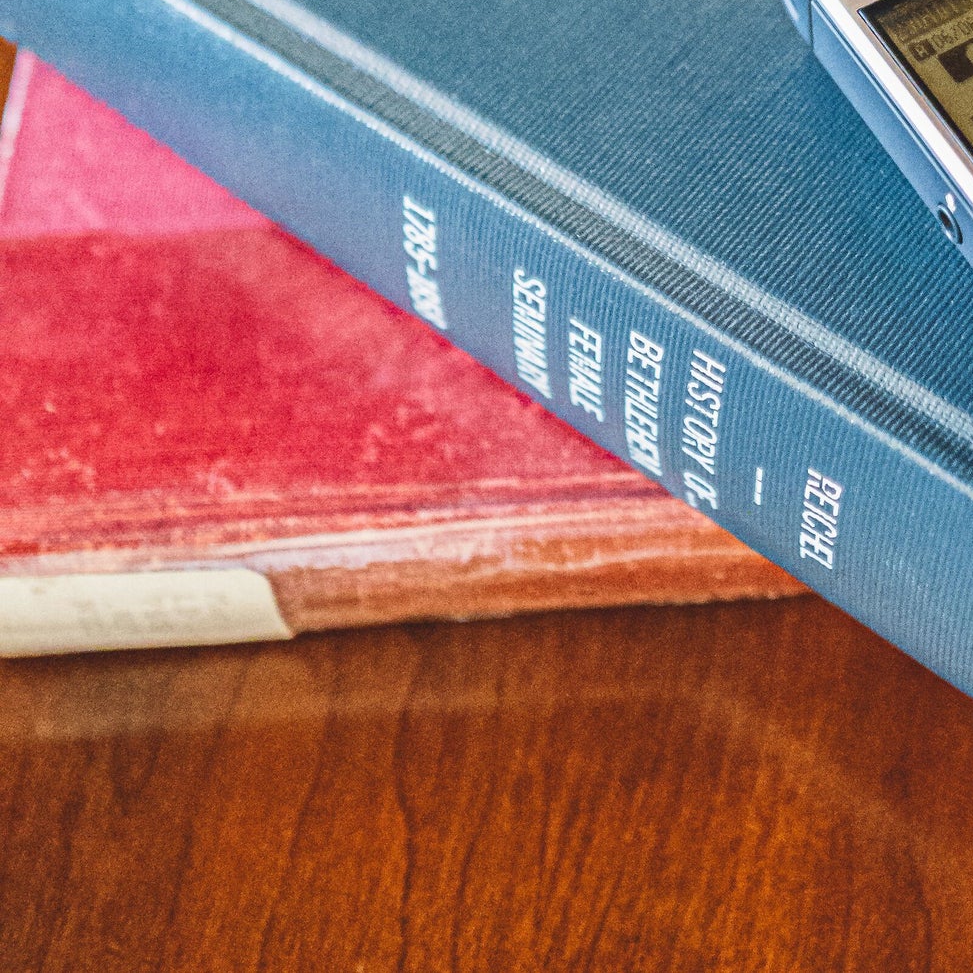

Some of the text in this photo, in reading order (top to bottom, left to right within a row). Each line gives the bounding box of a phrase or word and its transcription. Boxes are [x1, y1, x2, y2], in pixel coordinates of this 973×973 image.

[512, 268, 552, 399] SEMINARY
[569, 317, 605, 423] FEMALE
[682, 349, 726, 477] HISTORY
[799, 467, 843, 570] REICHEL
